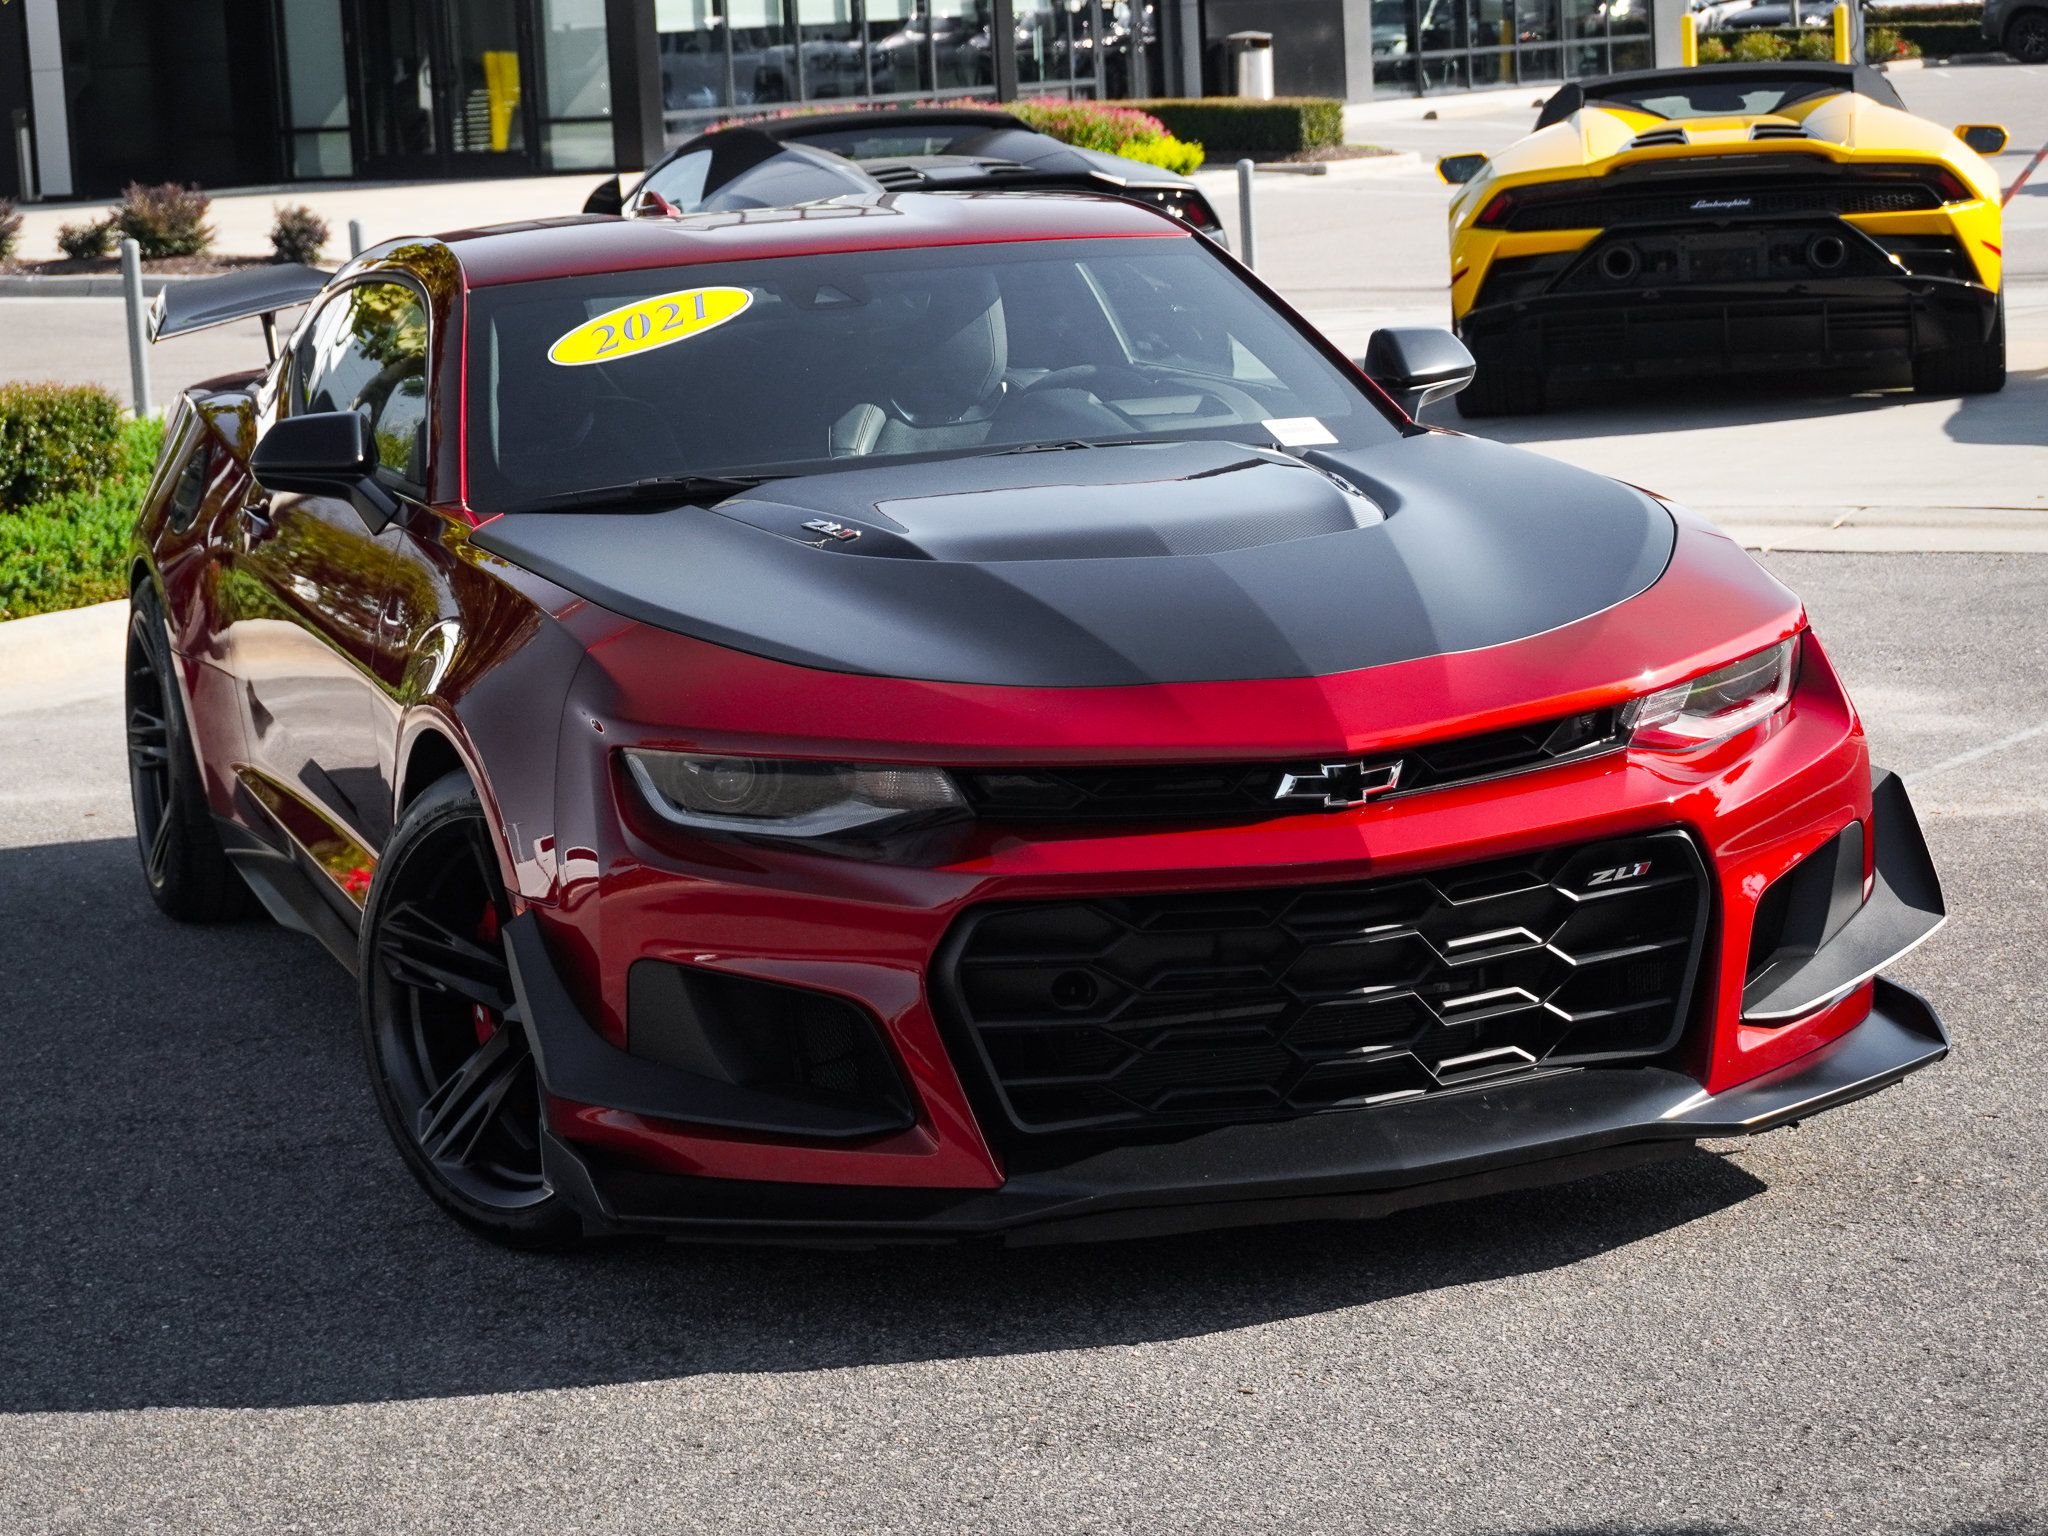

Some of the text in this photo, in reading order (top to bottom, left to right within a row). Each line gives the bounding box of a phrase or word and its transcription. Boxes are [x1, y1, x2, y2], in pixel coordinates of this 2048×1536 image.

[1690, 198, 1751, 209] Lamborghini
[591, 293, 706, 355] 2021
[1587, 861, 1651, 886] ZL1
